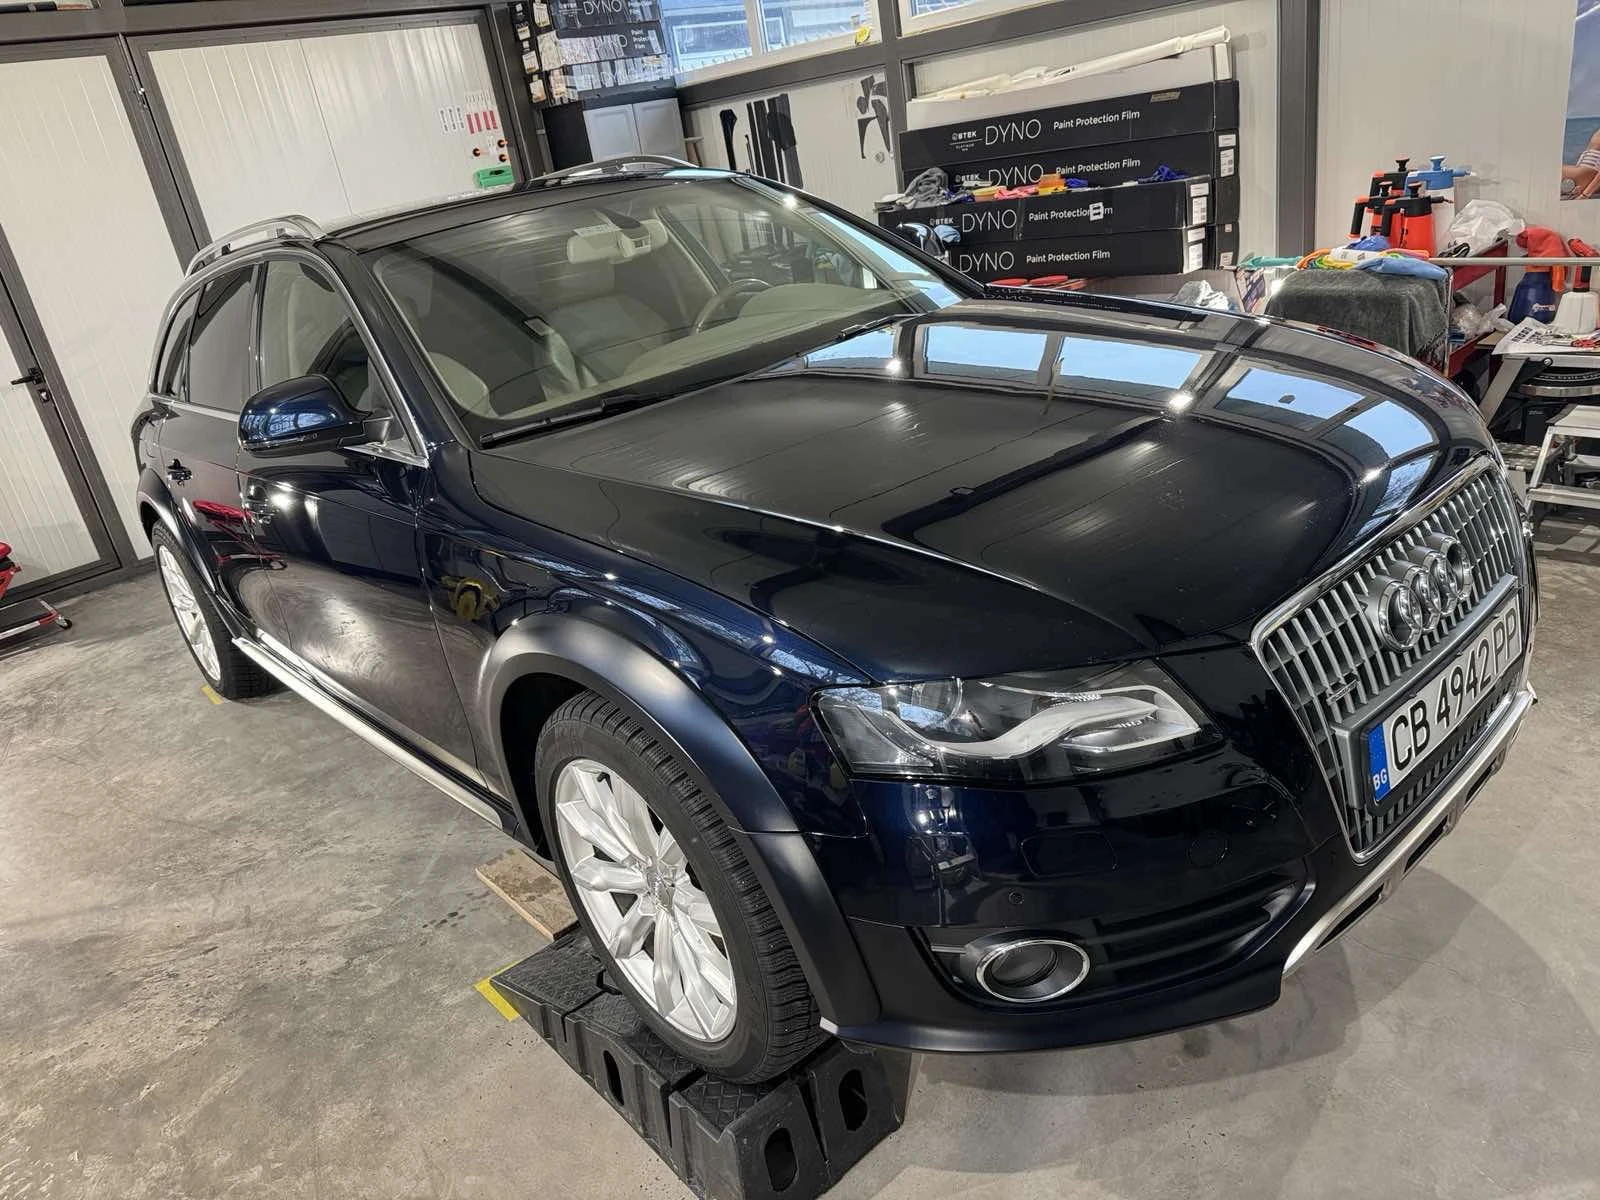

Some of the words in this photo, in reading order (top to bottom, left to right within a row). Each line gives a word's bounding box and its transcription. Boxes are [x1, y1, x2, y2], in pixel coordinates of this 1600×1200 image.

[583, 0, 622, 15] DYNO
[1053, 120, 1074, 131] Paint
[1075, 113, 1120, 127] Protection
[1121, 110, 1141, 121] Film
[985, 118, 1042, 146] DYNO
[988, 163, 1044, 187] DYNO
[1055, 165, 1076, 176] Paint
[1077, 160, 1121, 173] Protection
[1122, 158, 1141, 168] Film
[962, 209, 1017, 233] DYNO
[1028, 212, 1049, 222] Paint
[959, 251, 1015, 274] DYNO
[1026, 254, 1047, 264] Paint
[1047, 252, 1090, 262] Protection
[1092, 249, 1111, 260] Film
[1391, 699, 1431, 772] CB
[1373, 768, 1388, 790] BG
